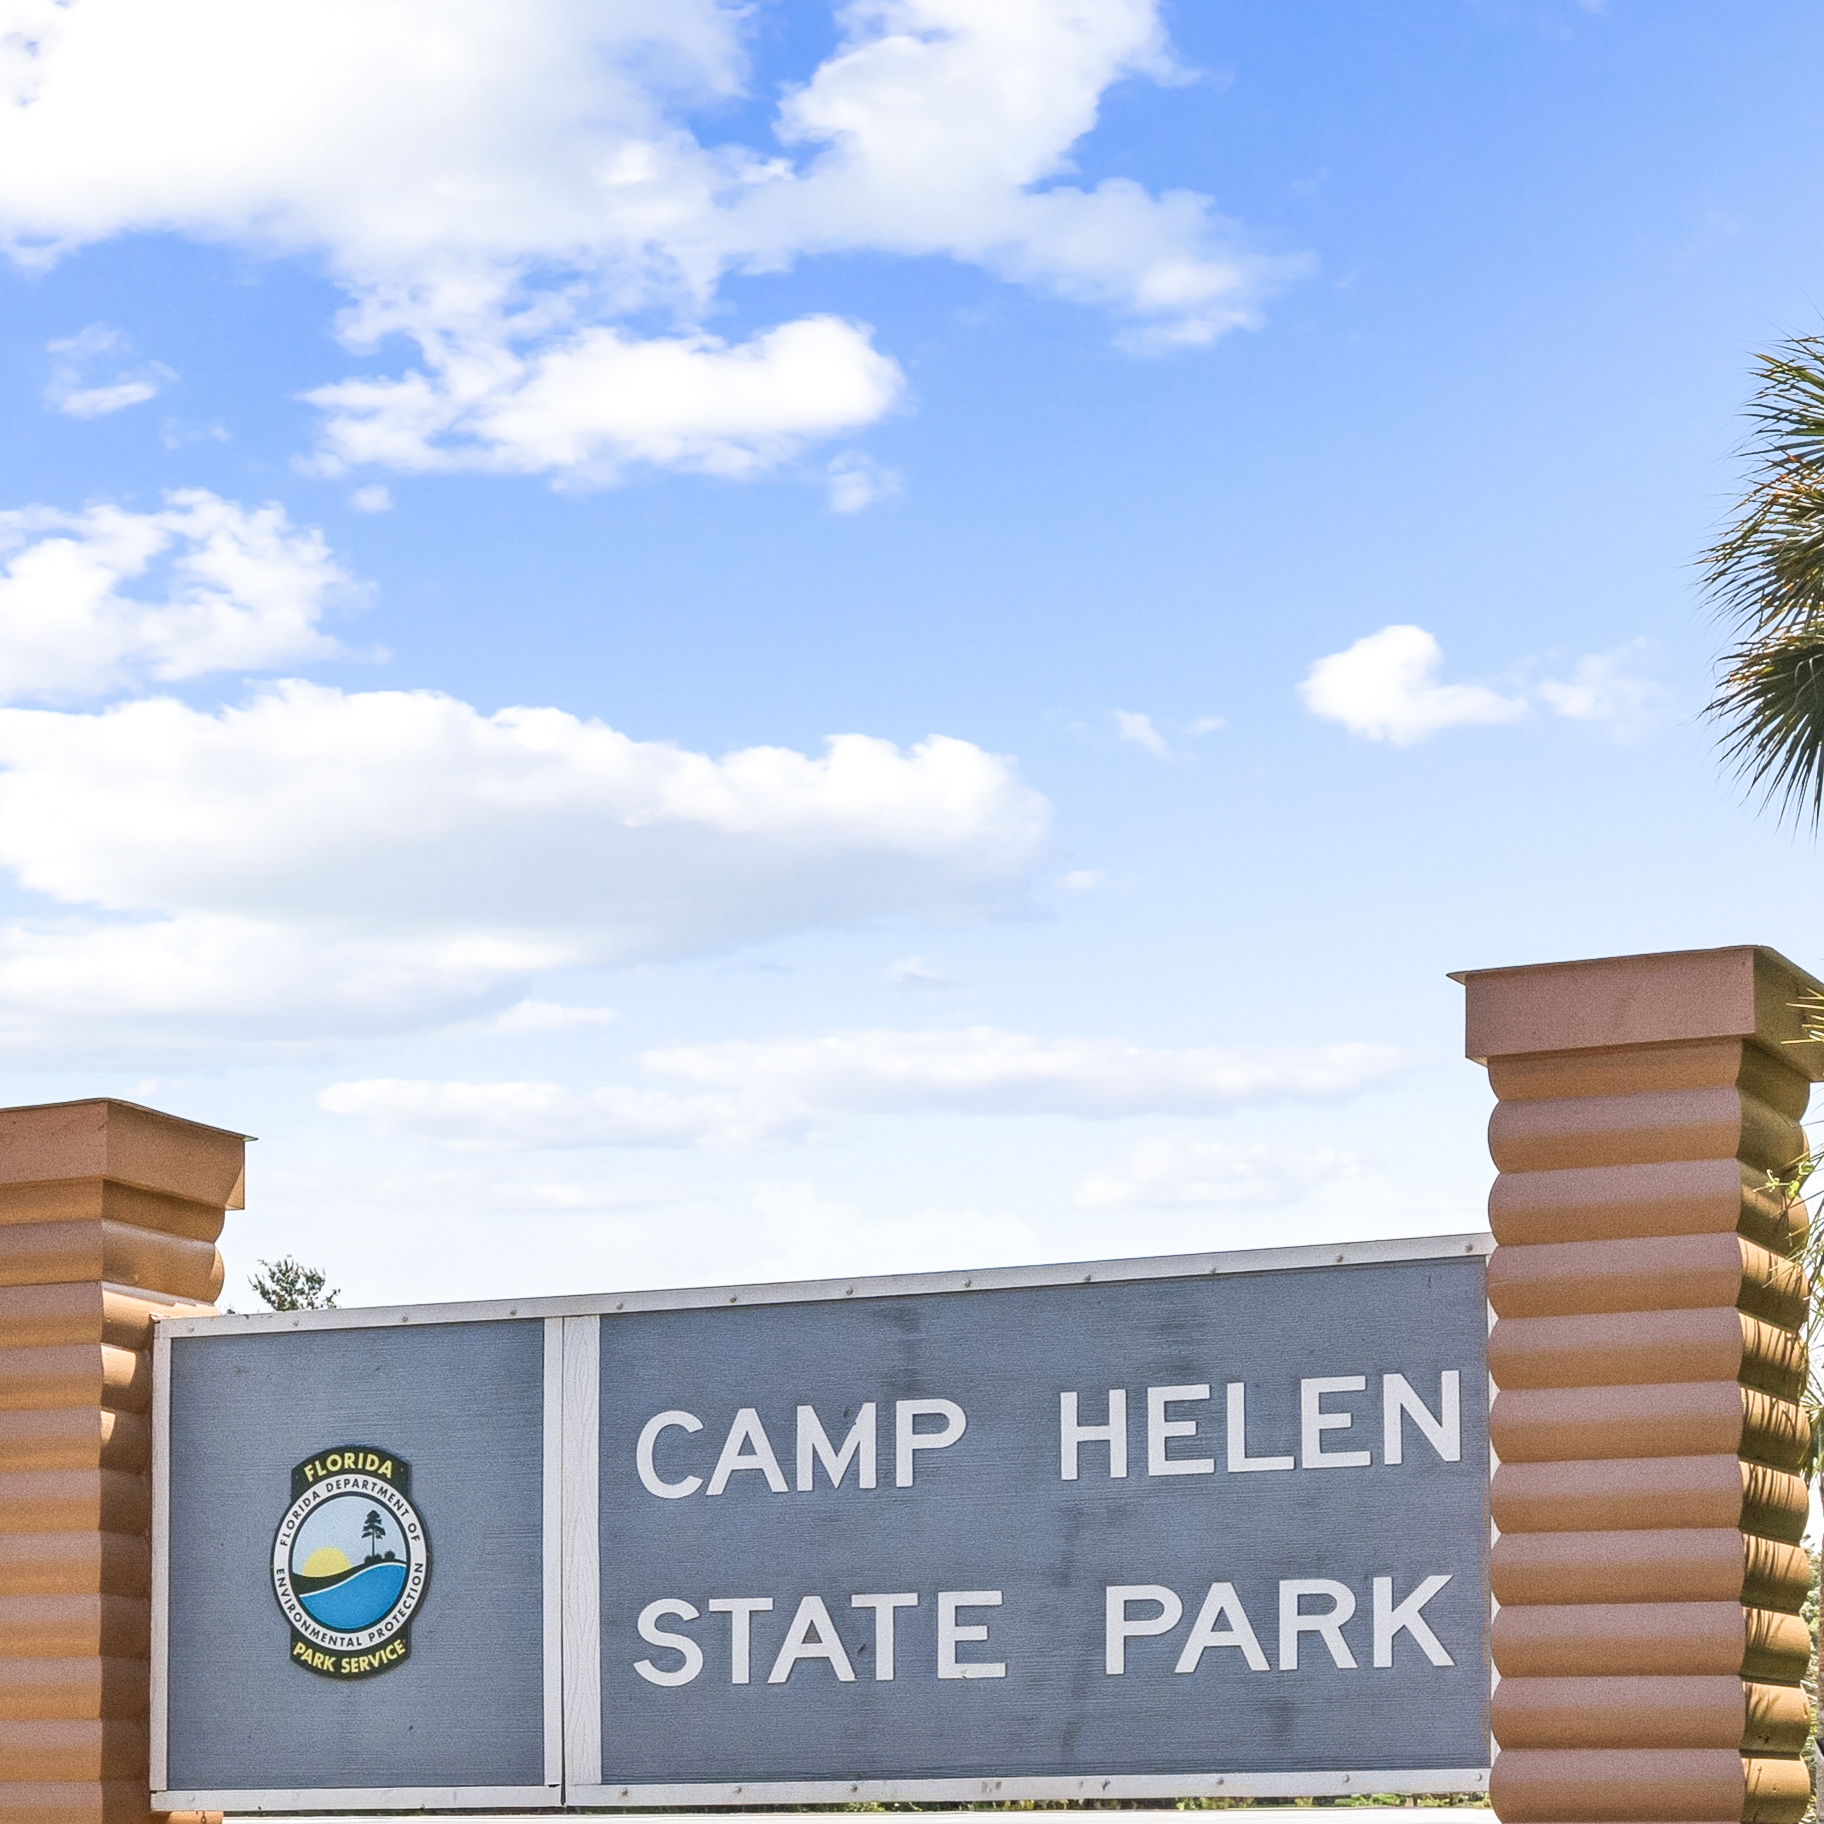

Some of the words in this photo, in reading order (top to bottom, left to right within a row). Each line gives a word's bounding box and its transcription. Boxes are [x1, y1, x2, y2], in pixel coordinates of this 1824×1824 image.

[303, 1452, 394, 1483] FLORIDA
[635, 1398, 968, 1499] CAMP
[1060, 1369, 1462, 1481] HELEN
[280, 1490, 321, 1547] FLORIDA
[325, 1477, 409, 1518] DEPARTMENT
[407, 1522, 420, 1543] OF
[276, 1568, 363, 1648] ENVIRONMENTAL
[368, 1562, 424, 1642] PROTECTION
[633, 1590, 1007, 1687] STATE
[1104, 1574, 1456, 1675] PARK
[293, 1641, 335, 1672] PARK
[340, 1639, 406, 1674] SERVICE
